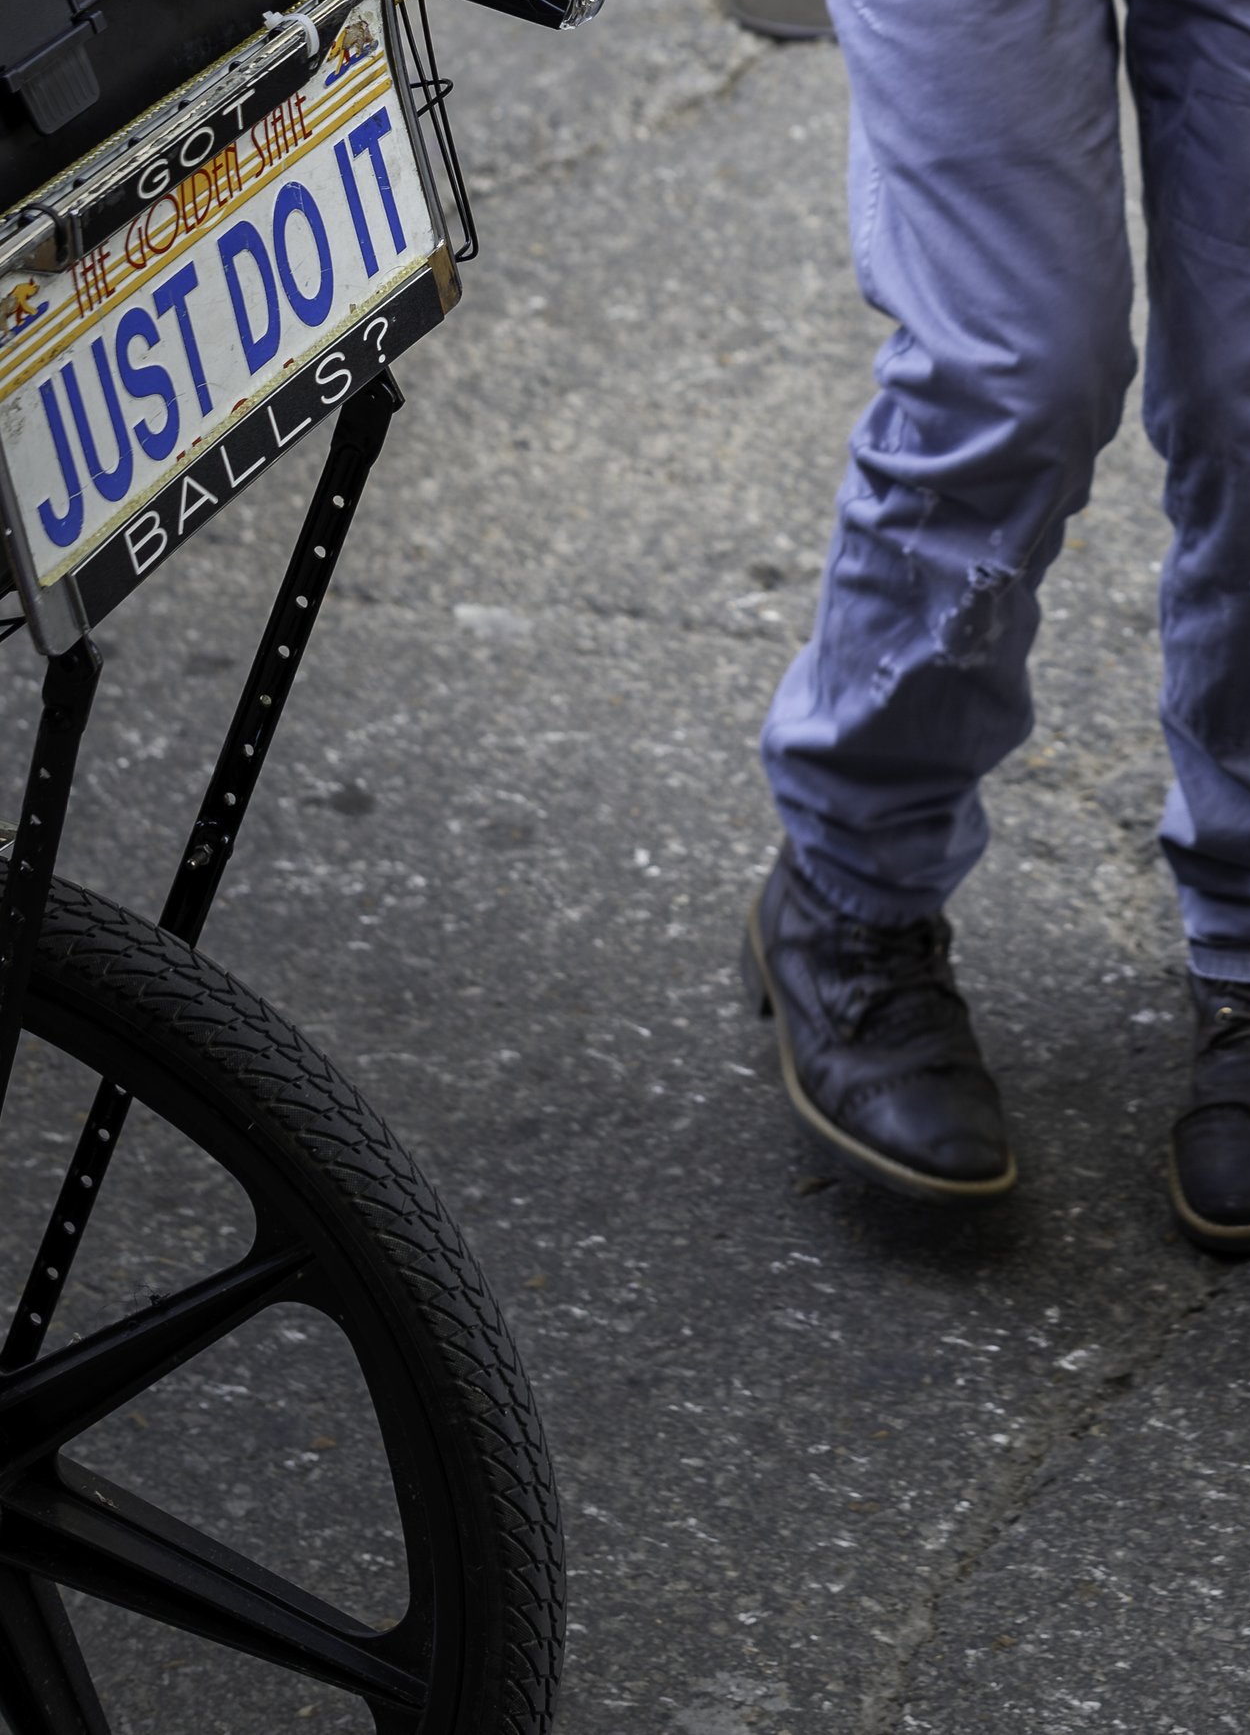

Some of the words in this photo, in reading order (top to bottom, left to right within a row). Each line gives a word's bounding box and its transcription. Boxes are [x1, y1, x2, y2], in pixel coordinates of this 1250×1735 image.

[68, 240, 115, 318] THE
[125, 141, 242, 270] GOLDEN
[251, 92, 312, 178] STATE
[137, 88, 255, 199] GOT
[37, 260, 213, 548] JUST
[217, 181, 334, 376] DO
[333, 105, 407, 279] IT
[123, 316, 389, 576] BALLS?
